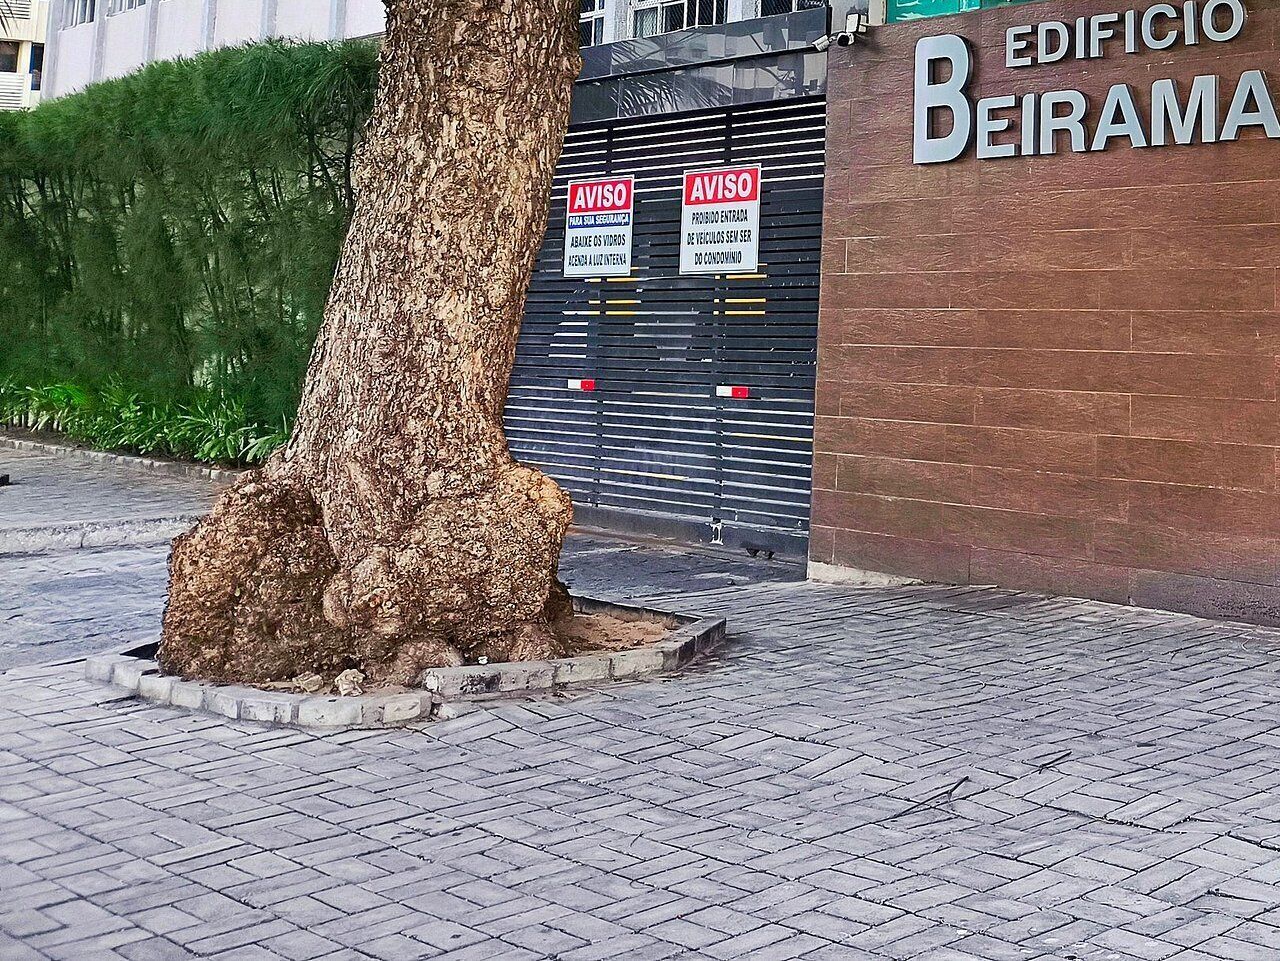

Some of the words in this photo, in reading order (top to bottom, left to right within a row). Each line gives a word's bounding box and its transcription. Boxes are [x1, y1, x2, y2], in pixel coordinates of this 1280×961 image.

[691, 172, 752, 201] AVISO
[573, 183, 627, 209] AVISO
[569, 216, 583, 225] PARA
[583, 216, 595, 225] SUA
[595, 213, 629, 225] SEGURANÇA
[692, 210, 720, 225] PROIBIDO
[720, 208, 748, 223] ENTRADA
[570, 235, 592, 248] ABAIXE
[593, 234, 602, 247] OS
[603, 234, 626, 247] VIDROS
[687, 232, 695, 245] DE
[695, 229, 725, 245] VEÍCULOS
[725, 230, 739, 244] SEM
[739, 229, 752, 243] SER
[568, 254, 588, 267] ACENDA
[593, 253, 603, 266] LUZ
[603, 252, 626, 266] INTERNA
[694, 252, 703, 265] DO
[703, 248, 742, 265] CONDOMÍNIO
